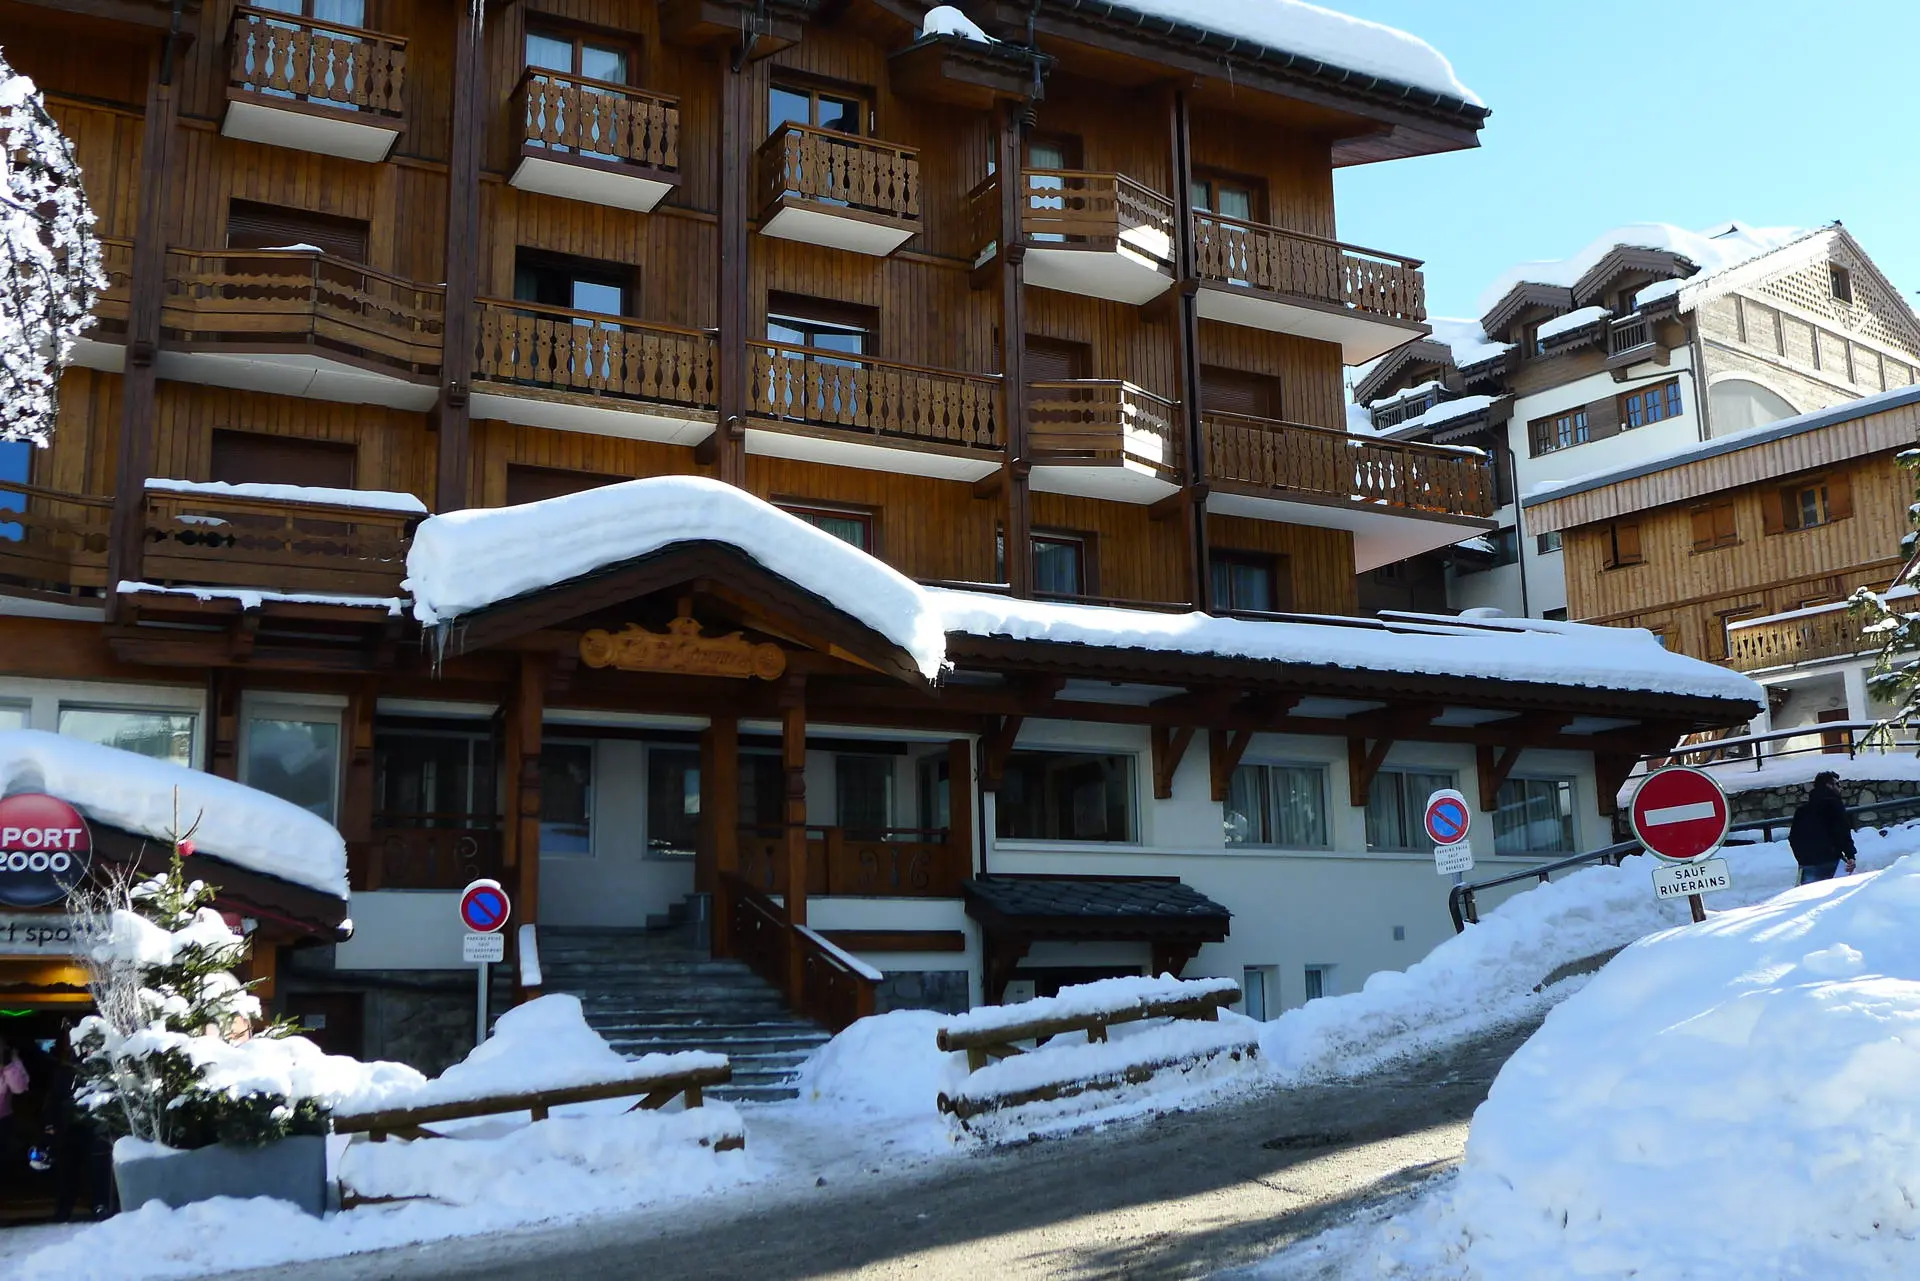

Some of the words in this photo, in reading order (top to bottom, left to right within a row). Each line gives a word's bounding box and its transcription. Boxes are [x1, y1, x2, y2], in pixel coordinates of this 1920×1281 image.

[0, 827, 82, 848] PORT
[1675, 866, 1706, 880] SAUF
[1660, 876, 1726, 896] RIVERAINS
